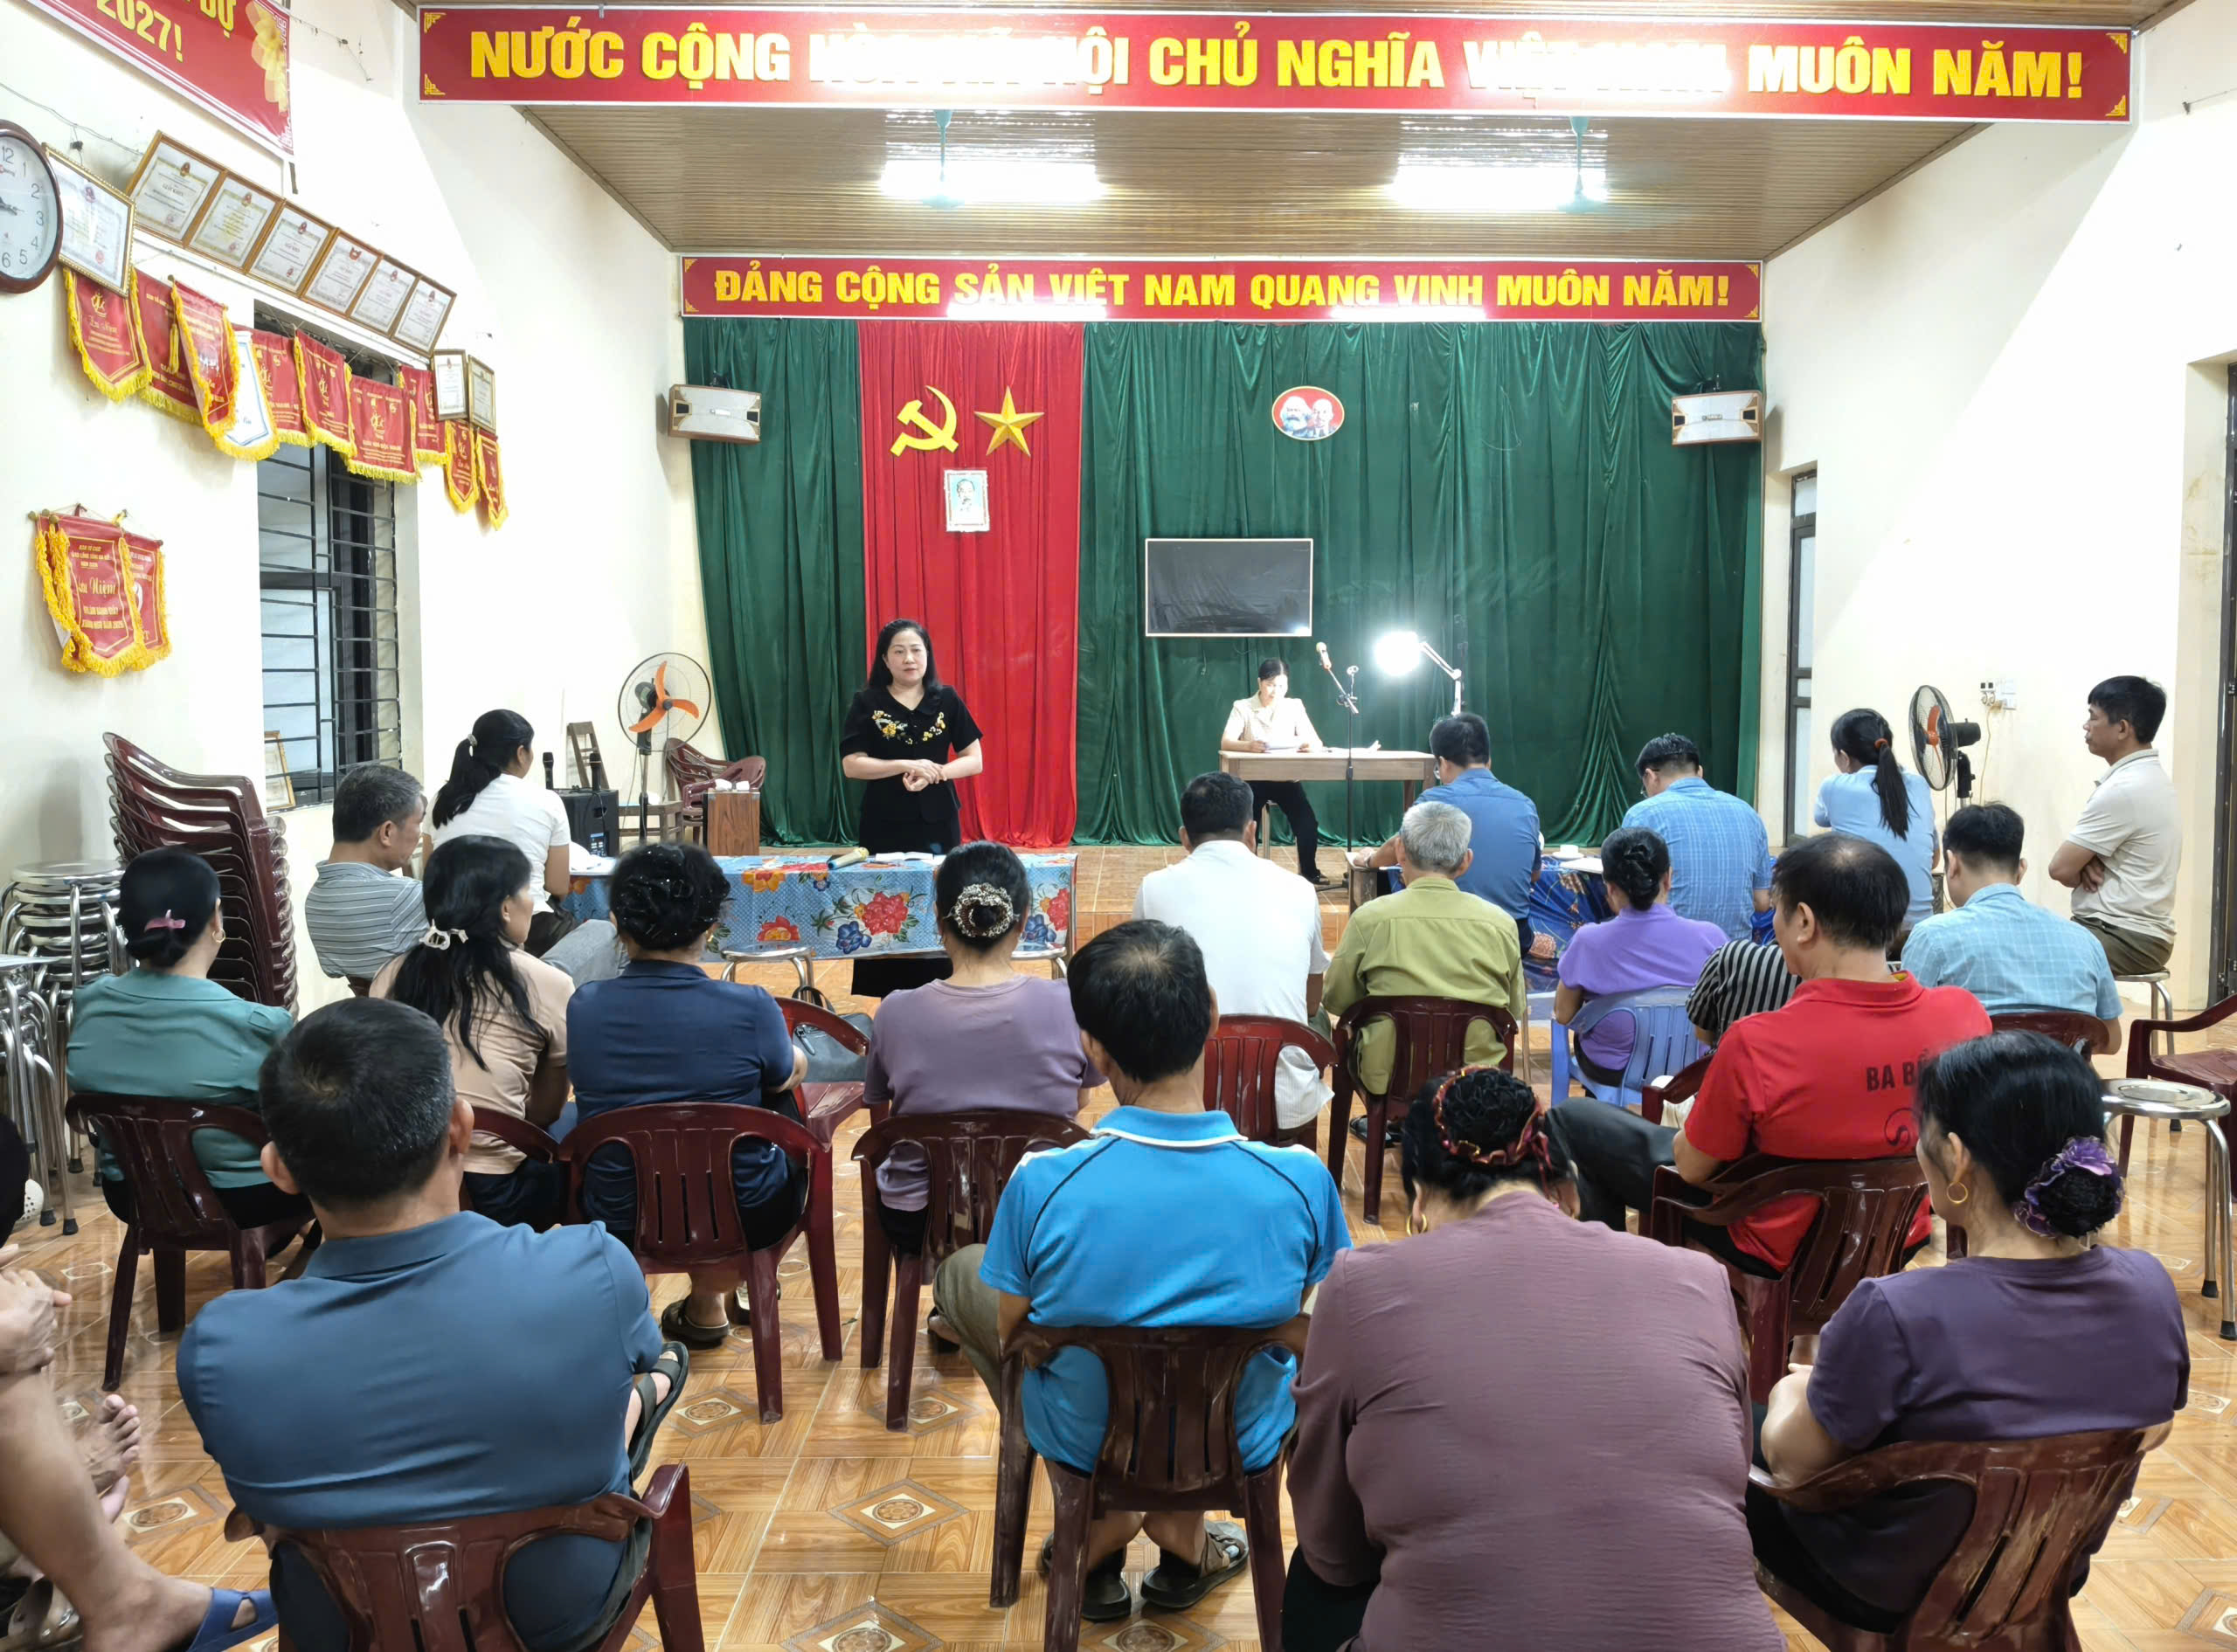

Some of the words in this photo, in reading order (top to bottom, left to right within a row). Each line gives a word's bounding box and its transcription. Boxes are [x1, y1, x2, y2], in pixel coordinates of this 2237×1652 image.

[471, 17, 624, 79] NƯỚC
[642, 23, 791, 89] CỘNG
[1042, 26, 1130, 94] ỘI
[1148, 21, 1258, 87] CHỦ
[1278, 31, 1445, 89] NGHĨA
[1748, 36, 1911, 95] MUÔN
[1932, 40, 2083, 100] NĂM!
[715, 260, 822, 303] ĐẢNG
[836, 266, 940, 310] CỘNG
[953, 263, 1036, 307] SẢN
[1145, 273, 1236, 307] NAM
[1250, 273, 1381, 309] QUANG
[1393, 274, 1484, 308] VINH
[1497, 268, 1610, 307] MUÔN
[1623, 268, 1729, 307] NĂM!
[1866, 1064, 1895, 1092] BA
